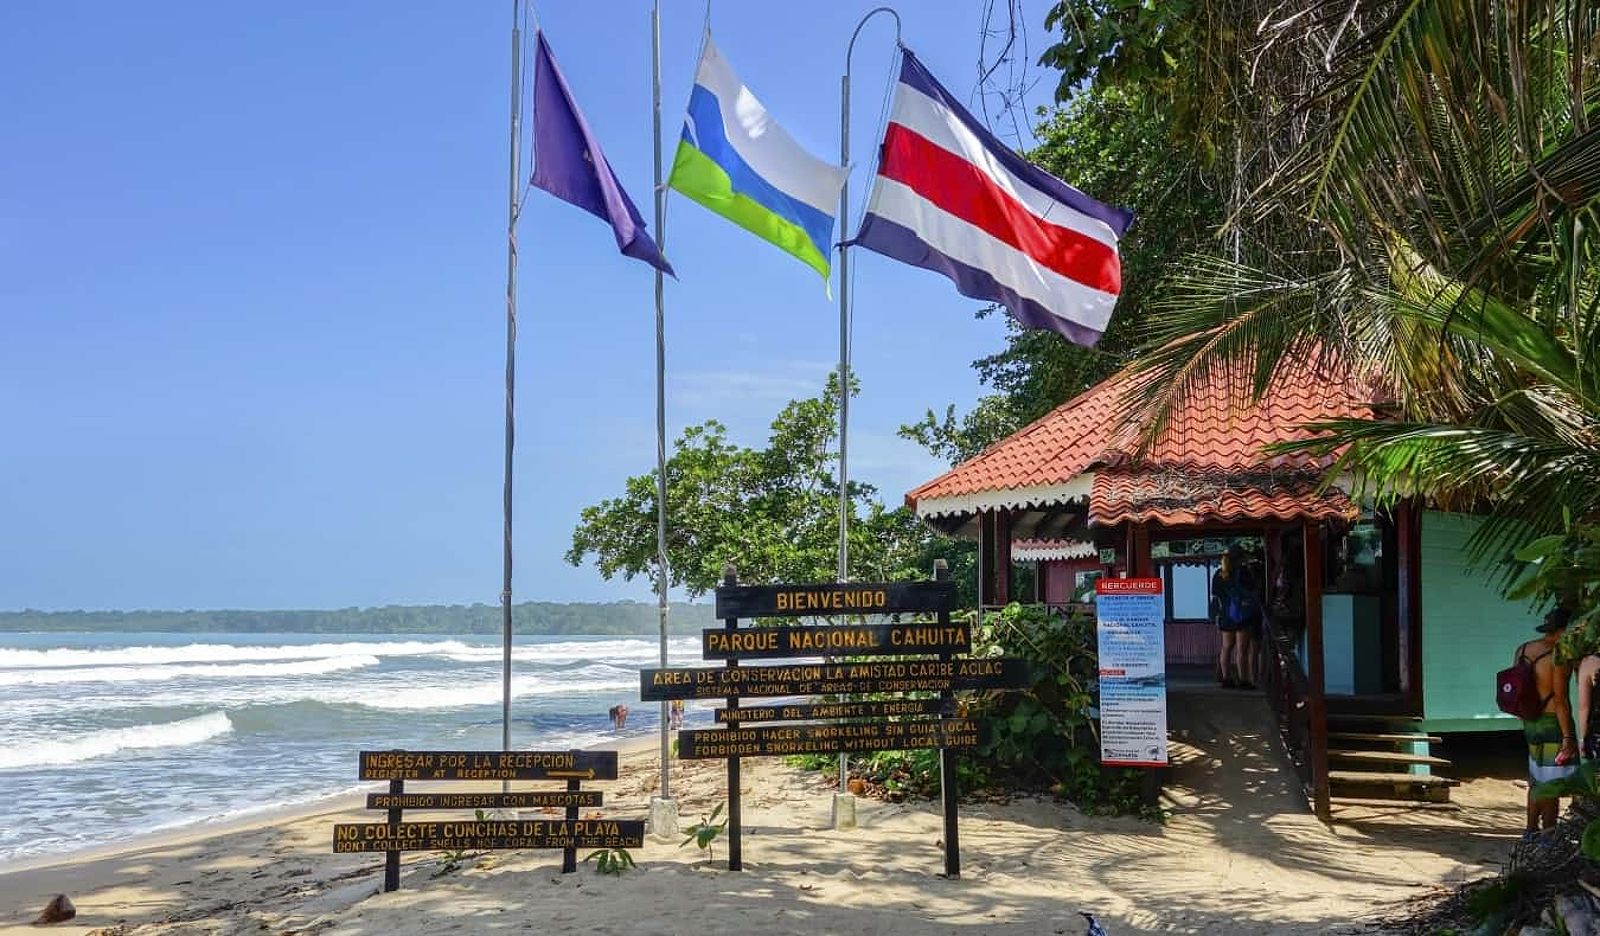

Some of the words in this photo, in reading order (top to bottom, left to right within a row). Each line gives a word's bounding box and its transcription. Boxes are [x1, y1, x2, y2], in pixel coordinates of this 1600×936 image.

[777, 591, 886, 610] BIENVENIDO
[709, 633, 778, 651] PARQUE
[790, 630, 879, 649] NACIONAL
[891, 627, 966, 646] CAHUITA
[653, 671, 692, 685] AREA
[697, 671, 715, 683] DE
[721, 667, 821, 683] CONSERVACION
[826, 666, 843, 680] LA
[850, 664, 906, 679] AMISTAD
[909, 662, 954, 677] CARIBE
[696, 686, 740, 695] SISTEMA
[748, 684, 792, 695] NACIONAL
[800, 683, 813, 693] DE
[820, 681, 853, 692] AREAS
[860, 681, 872, 691] DE
[878, 679, 950, 691] CONSERVACION
[720, 709, 775, 720] MINISTERIO
[783, 708, 803, 718] DEL
[812, 704, 864, 718] AMBIENTE
[871, 704, 878, 714] Y
[694, 730, 757, 742] PROHIBIDO
[763, 729, 800, 740] HACER
[807, 725, 879, 738] SNORKELING
[886, 724, 904, 736] SIN
[910, 723, 936, 734] GUIA
[941, 721, 977, 732] LOCAL
[694, 743, 760, 755] FORBIDDEN
[766, 740, 839, 753] SNORKELING
[845, 737, 895, 749] WITHOUT
[903, 737, 940, 747] LOCAL
[946, 735, 977, 746] GUIDE
[366, 753, 434, 769] INGRESAR
[440, 755, 467, 768] POR
[474, 756, 491, 768] LA
[500, 755, 573, 768] RECEPCION
[365, 768, 418, 778] REGISTER
[433, 769, 446, 778] AT
[457, 768, 516, 778] RECEPTION
[375, 796, 434, 807] PROHIBIDO
[440, 795, 495, 807] INGRESAR
[503, 796, 526, 806] CON
[533, 794, 594, 806] MASCOTAS
[338, 825, 359, 841] NO
[365, 824, 437, 840] COLECTE
[523, 821, 543, 836] DE
[549, 821, 568, 836] LA
[575, 821, 619, 836] PLAYA
[373, 839, 423, 851] COLLECT
[431, 838, 471, 849] SHELLS
[546, 836, 574, 847] FROM
[582, 836, 599, 847] THE
[606, 835, 640, 847] BEACH
